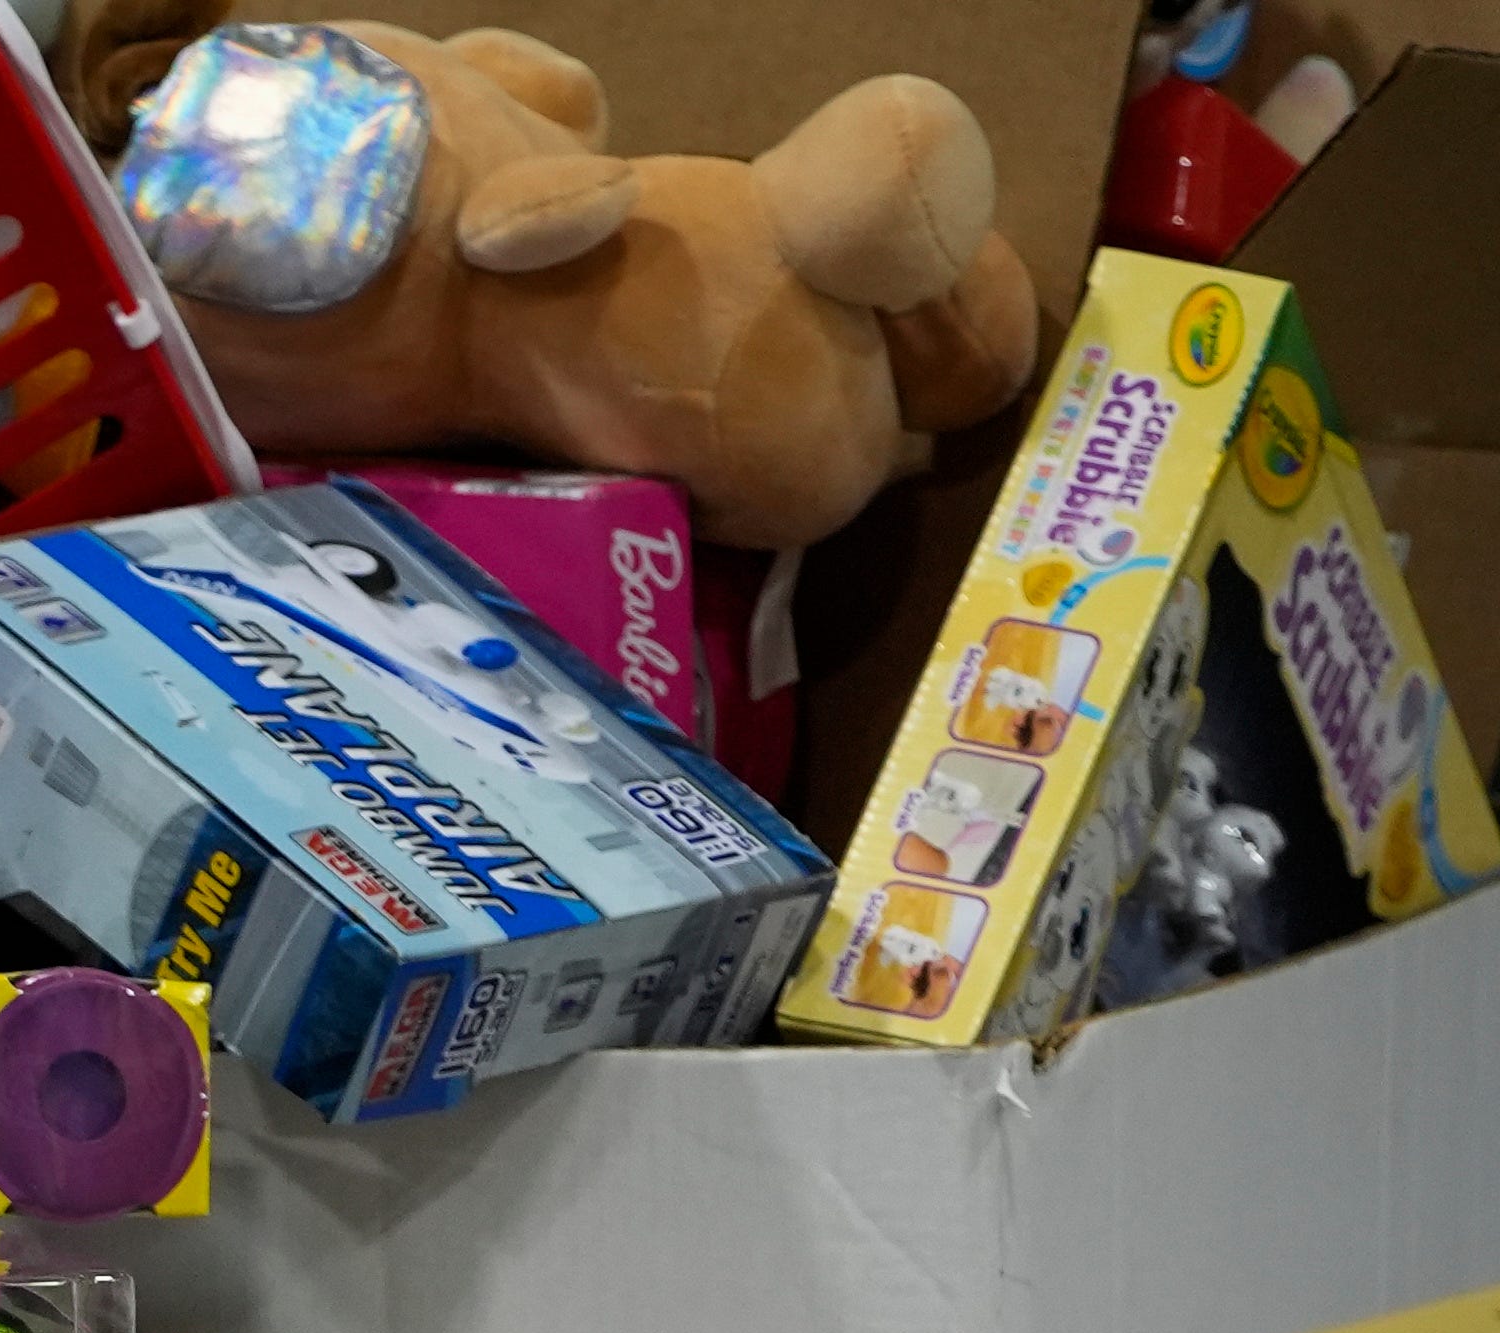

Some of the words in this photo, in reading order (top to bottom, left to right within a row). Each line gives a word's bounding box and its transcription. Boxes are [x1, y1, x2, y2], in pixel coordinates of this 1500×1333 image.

[611, 526, 684, 709] Barbi
[194, 619, 584, 901] AIRPLANE
[231, 703, 344, 770] JET
[184, 850, 241, 928] Me
[330, 780, 516, 918] JUMBO
